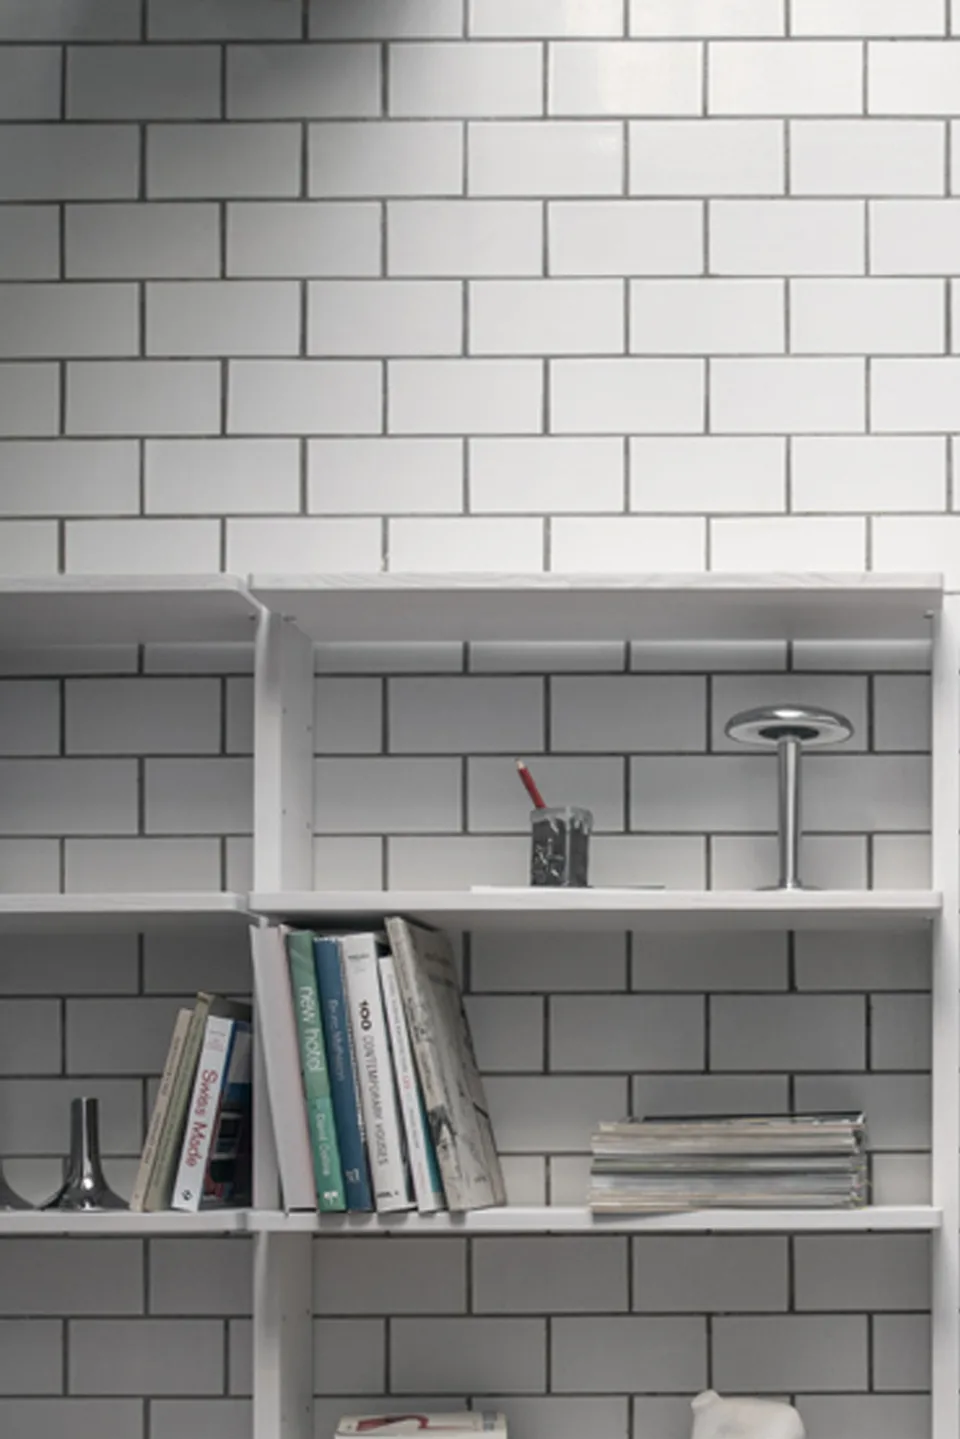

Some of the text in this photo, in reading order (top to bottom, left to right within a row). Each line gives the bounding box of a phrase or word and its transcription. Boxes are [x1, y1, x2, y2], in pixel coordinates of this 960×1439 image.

[299, 985, 317, 1023] new
[359, 1000, 373, 1031] 100
[194, 1068, 218, 1116] Swiss
[362, 1034, 386, 1122] CONTEMPORARY
[184, 1120, 208, 1168] Made
